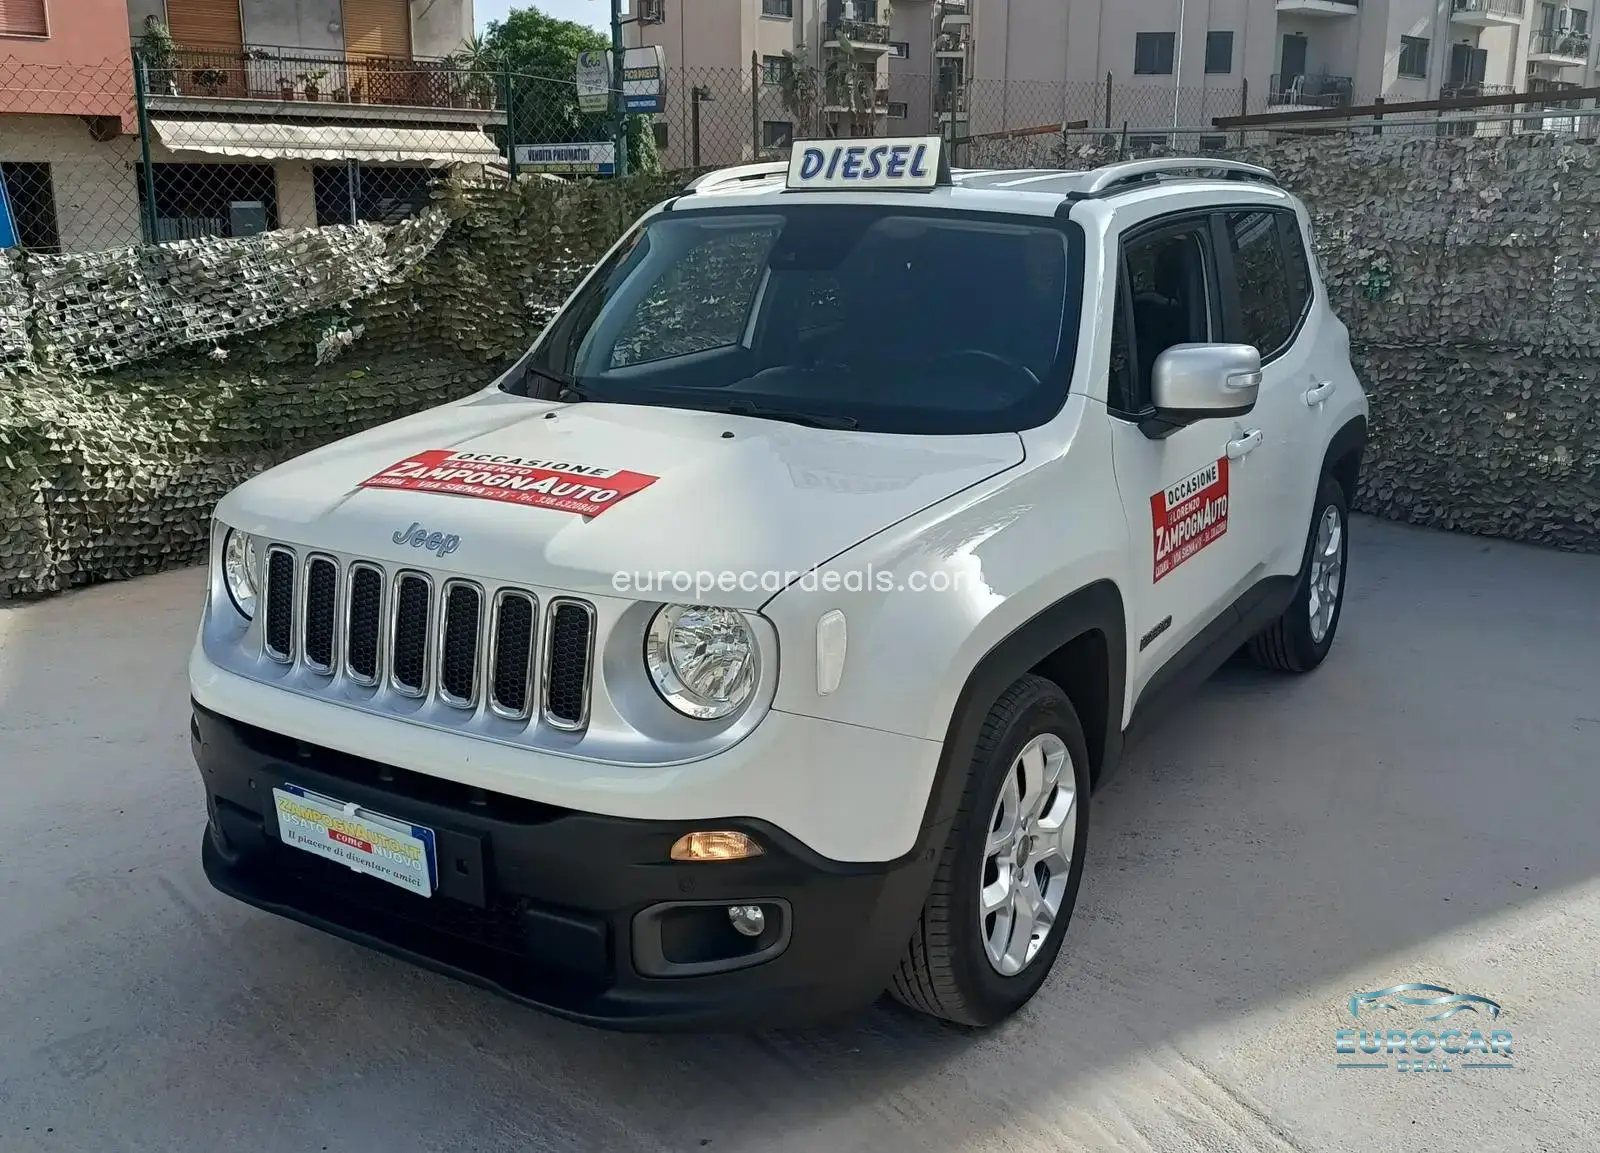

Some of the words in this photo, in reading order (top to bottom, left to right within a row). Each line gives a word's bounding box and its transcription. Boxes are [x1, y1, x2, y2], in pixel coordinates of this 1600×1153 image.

[527, 150, 552, 161] VENDITA
[553, 148, 590, 161] PNEUMATICI
[800, 144, 927, 180] DIESEL
[447, 462, 533, 475] LORENZO
[457, 453, 609, 476] OCCASIONE
[417, 481, 441, 489] VIA
[441, 484, 485, 494] SIENA
[1167, 465, 1217, 505] OCCASIONE
[1173, 496, 1201, 521] LORENZO
[392, 522, 460, 558] Jeep
[282, 812, 326, 834] USATO
[336, 833, 364, 848] come
[373, 845, 422, 871] NUOVO
[297, 834, 332, 852] piacere
[333, 845, 344, 857] di
[346, 850, 391, 875] diventare
[393, 868, 421, 887] amici
